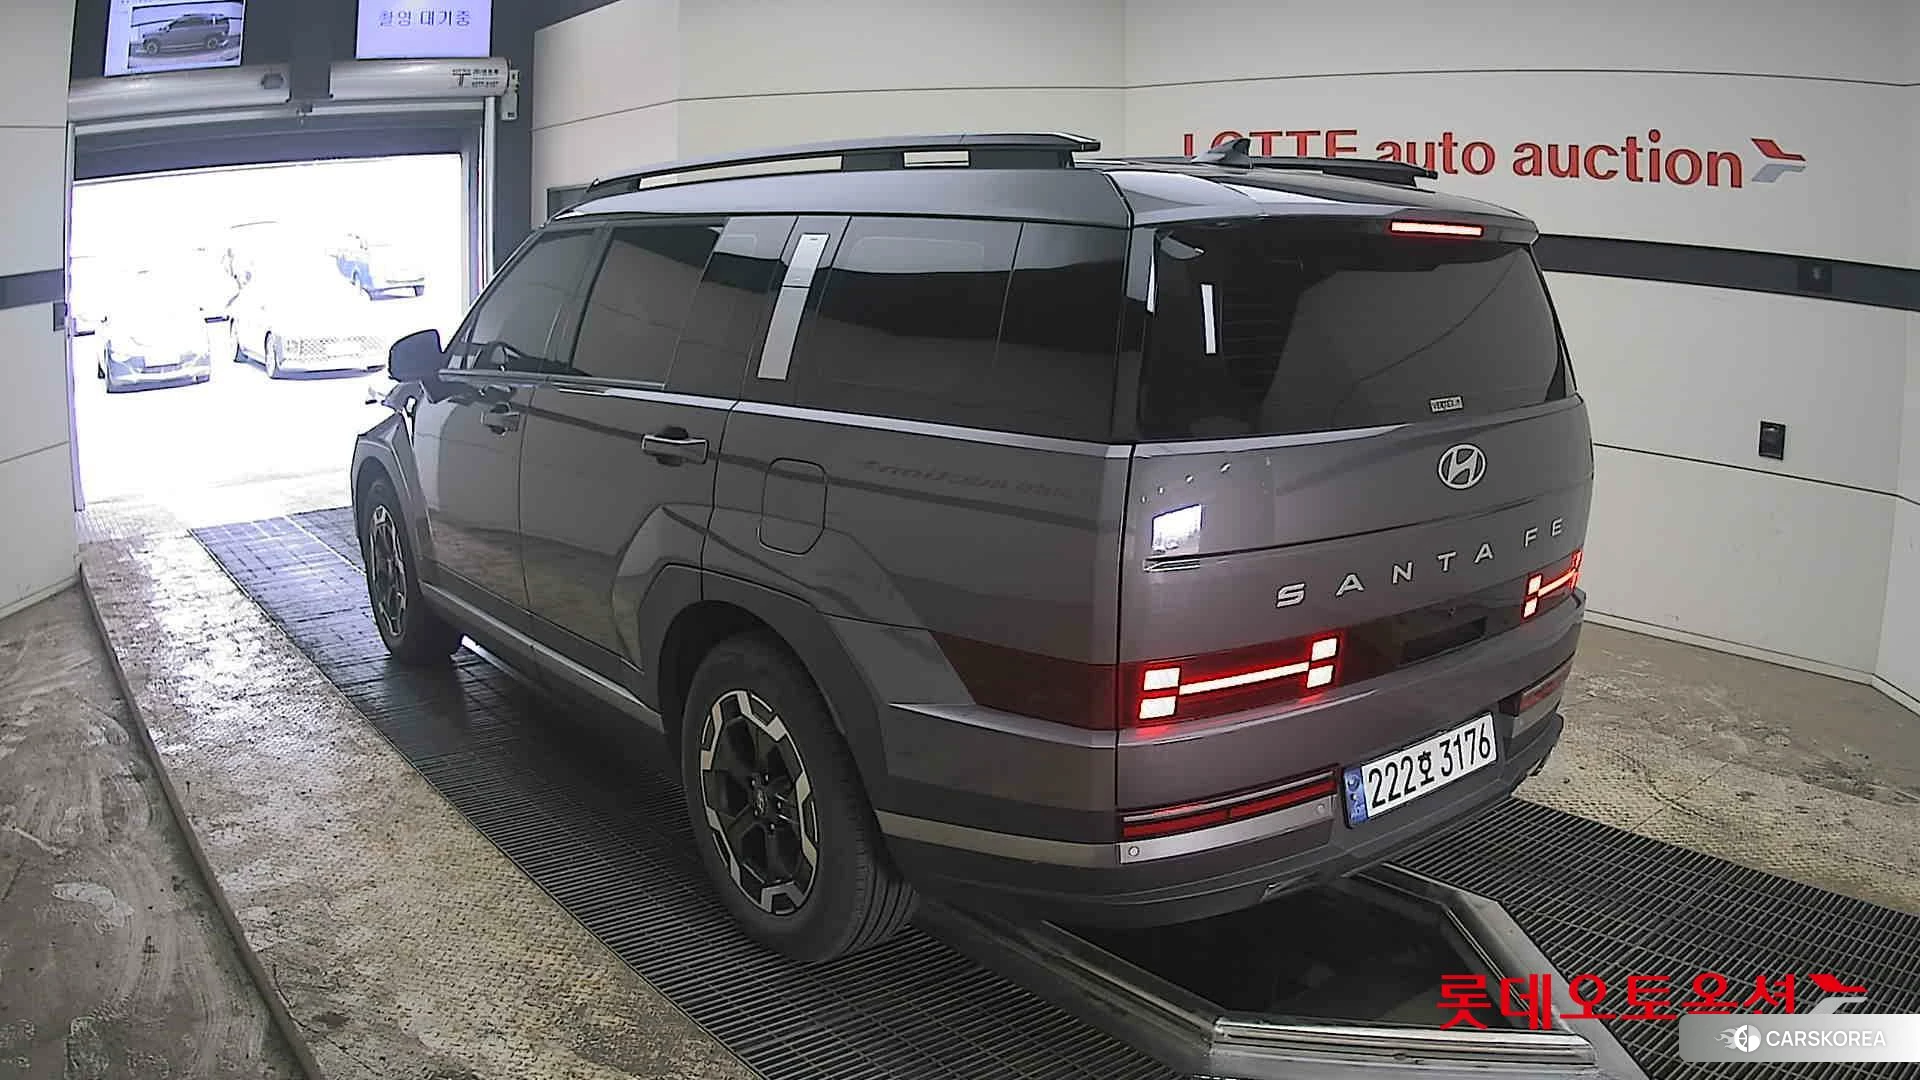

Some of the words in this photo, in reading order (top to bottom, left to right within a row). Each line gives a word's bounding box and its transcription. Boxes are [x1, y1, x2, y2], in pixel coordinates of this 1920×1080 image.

[420, 10, 471, 27] 대기중
[1184, 130, 1357, 158] TTE
[1512, 129, 1743, 188] auction
[1276, 543, 1494, 608] SANTA
[1524, 518, 1563, 547] FE
[1368, 751, 1435, 809] 222호
[1439, 723, 1491, 777] 3176
